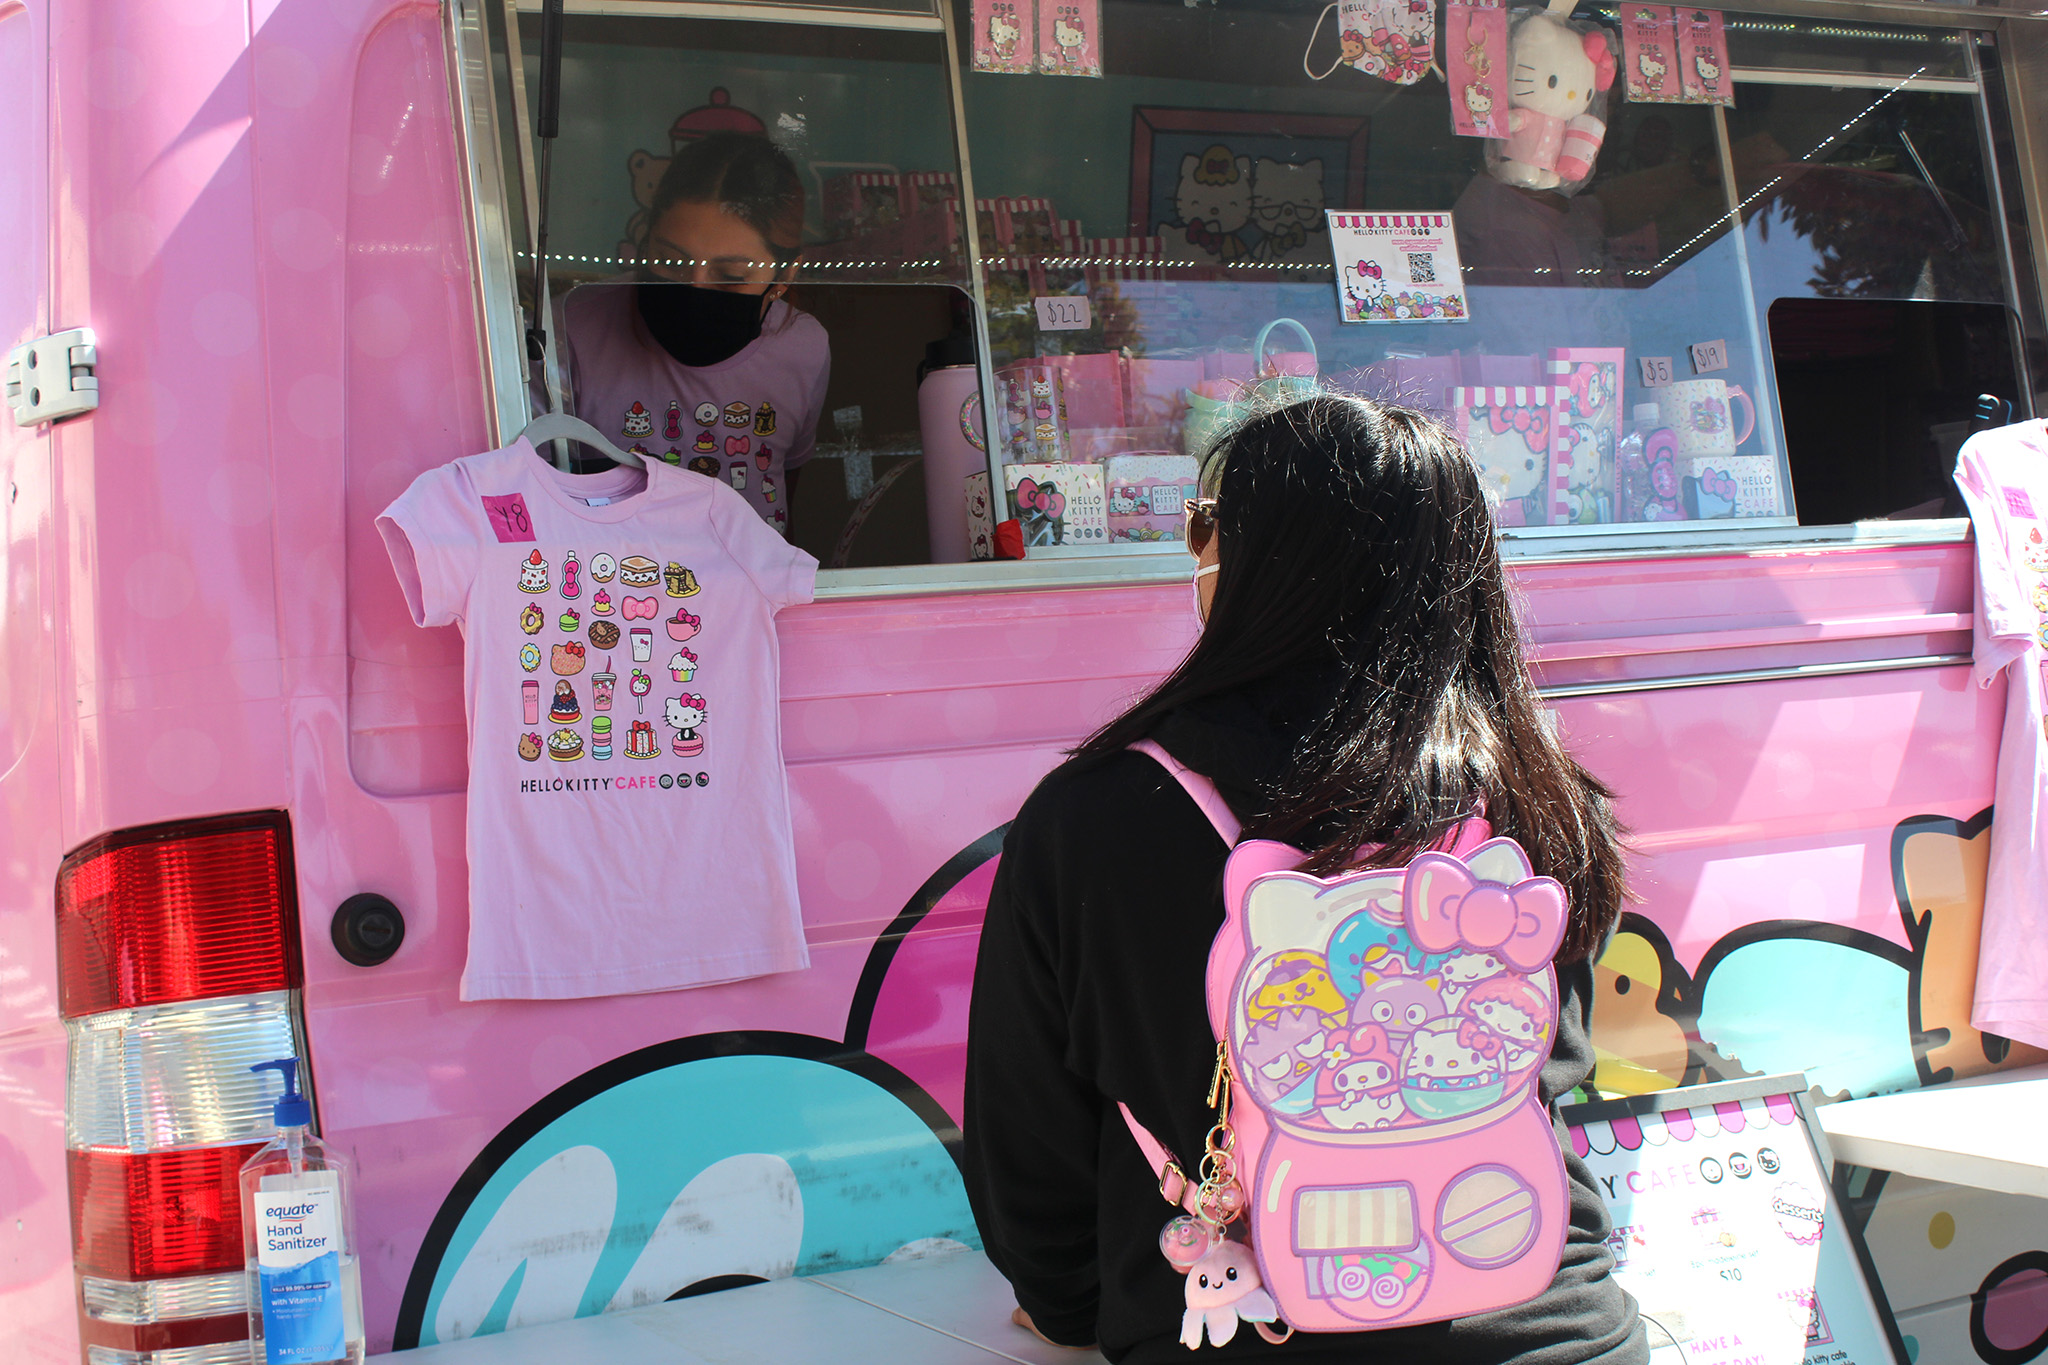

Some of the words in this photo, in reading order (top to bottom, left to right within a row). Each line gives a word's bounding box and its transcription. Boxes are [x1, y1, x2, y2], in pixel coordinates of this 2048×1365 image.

[1394, 228, 1411, 236] CAFE
[1047, 300, 1082, 327] $22
[1696, 346, 1720, 369] $19
[1646, 359, 1669, 385] $5
[1742, 474, 1772, 485] HELLO
[1154, 487, 1178, 496] HELLO
[1743, 487, 1772, 497] KITTY
[1071, 495, 1101, 505] HELLO
[1744, 498, 1774, 508] CAFE
[1072, 506, 1101, 515] KITTY
[1156, 504, 1180, 512] CAFE
[1072, 517, 1102, 526] CAFE
[615, 775, 656, 790] CAFE
[1626, 1163, 1697, 1194] CAFE
[1772, 1197, 1824, 1224] desserts
[266, 1222, 303, 1237] Hand
[268, 1236, 327, 1251] Sanitizer
[271, 1298, 288, 1306] with
[288, 1296, 317, 1305] Vitamin
[318, 1295, 323, 1303] E
[1690, 1335, 1728, 1354] HAVE
[1733, 1334, 1743, 1347] A
[1811, 1355, 1830, 1365] kitty
[1830, 1349, 1848, 1361] cafe
